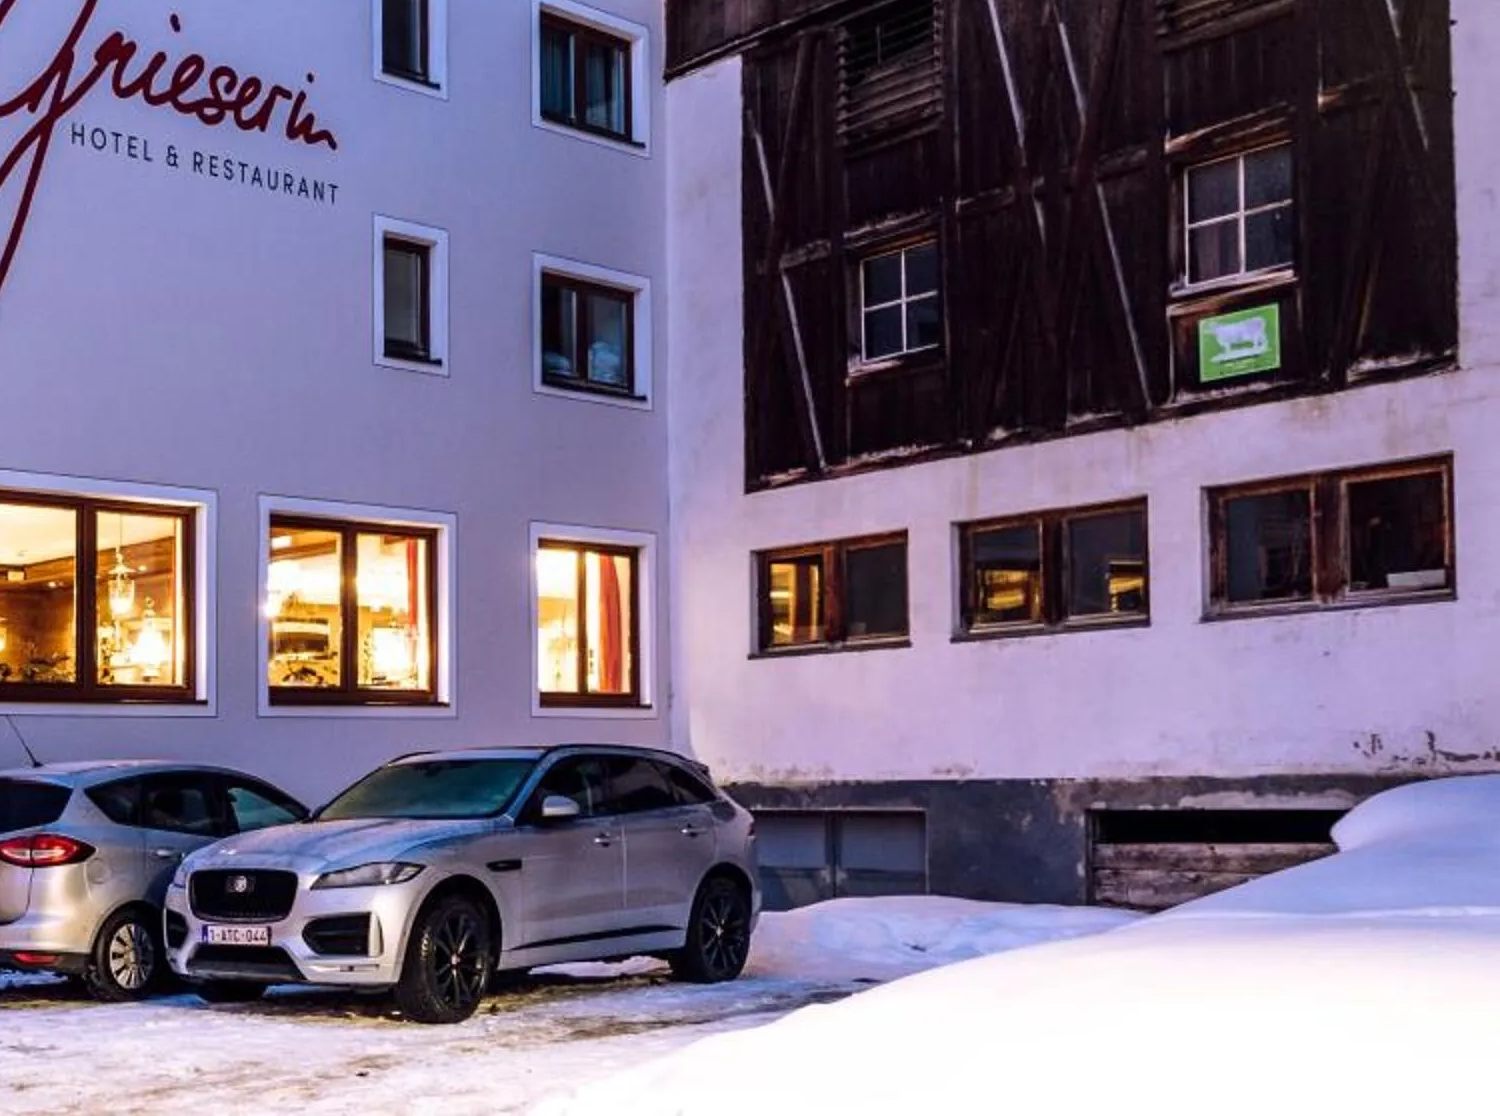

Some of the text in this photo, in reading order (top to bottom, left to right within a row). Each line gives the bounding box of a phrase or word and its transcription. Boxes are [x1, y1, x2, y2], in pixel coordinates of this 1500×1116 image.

[71, 123, 339, 205] HOTEL & RESTAURANT
